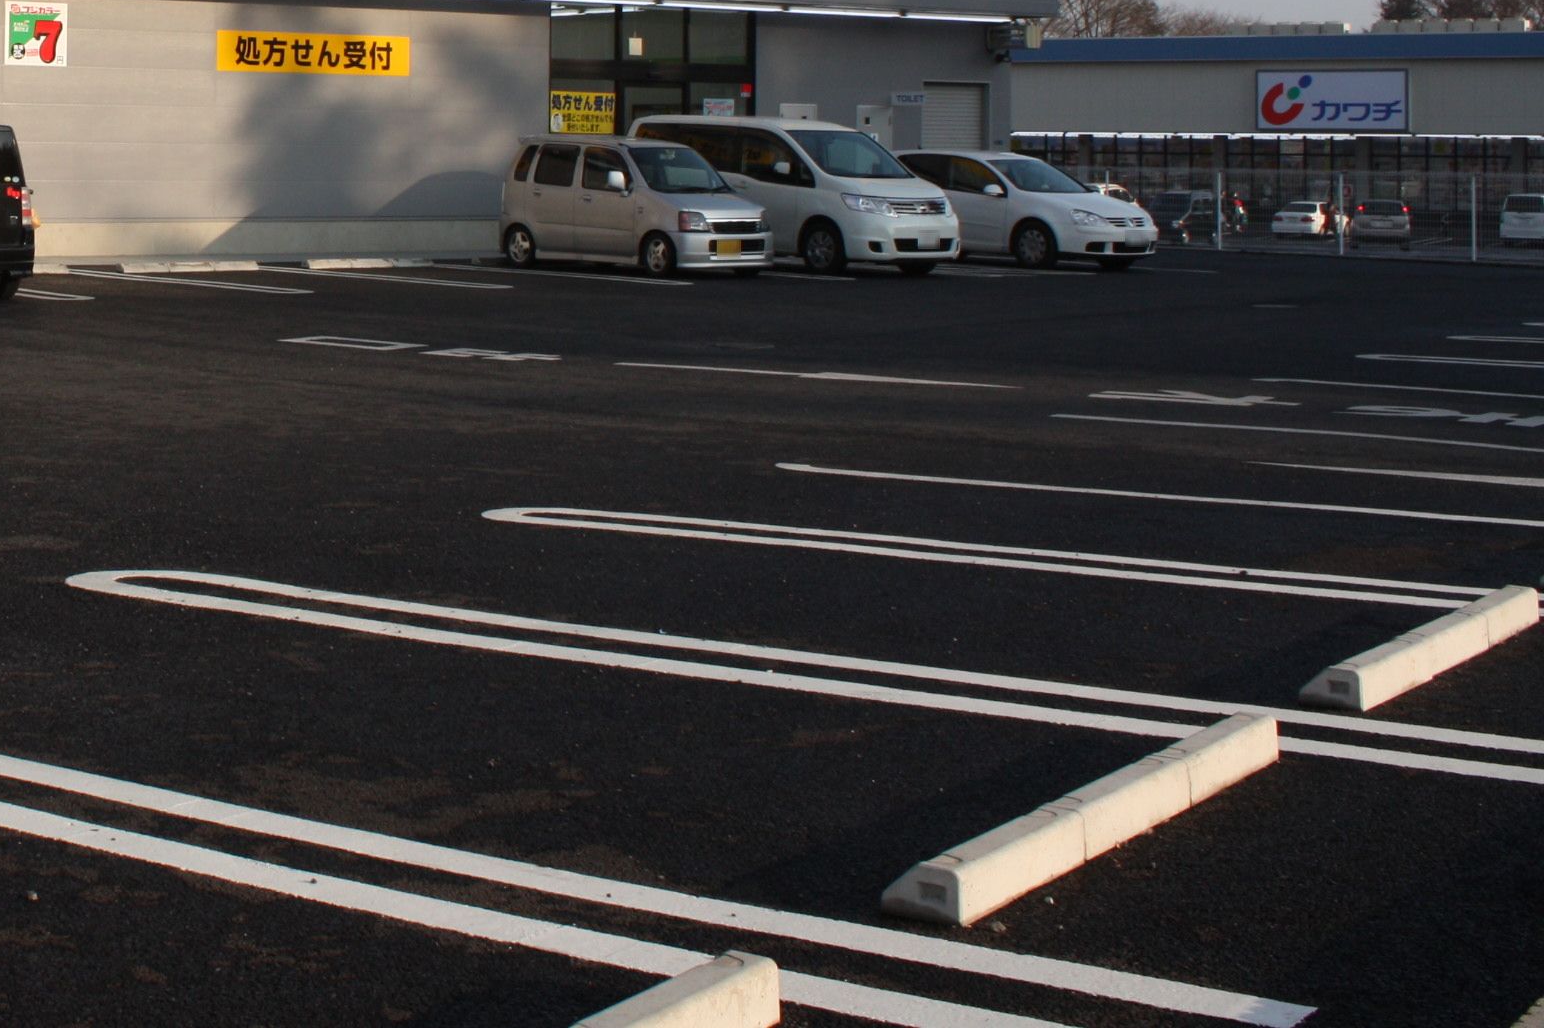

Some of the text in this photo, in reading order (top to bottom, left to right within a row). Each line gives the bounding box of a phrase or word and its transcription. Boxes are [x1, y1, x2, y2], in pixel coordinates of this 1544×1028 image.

[33, 20, 63, 63] 7
[235, 36, 393, 70] 処方せん受付
[552, 94, 616, 112] 処方せん受付
[896, 94, 924, 103] TOILET
[1311, 100, 1402, 121] カワチ
